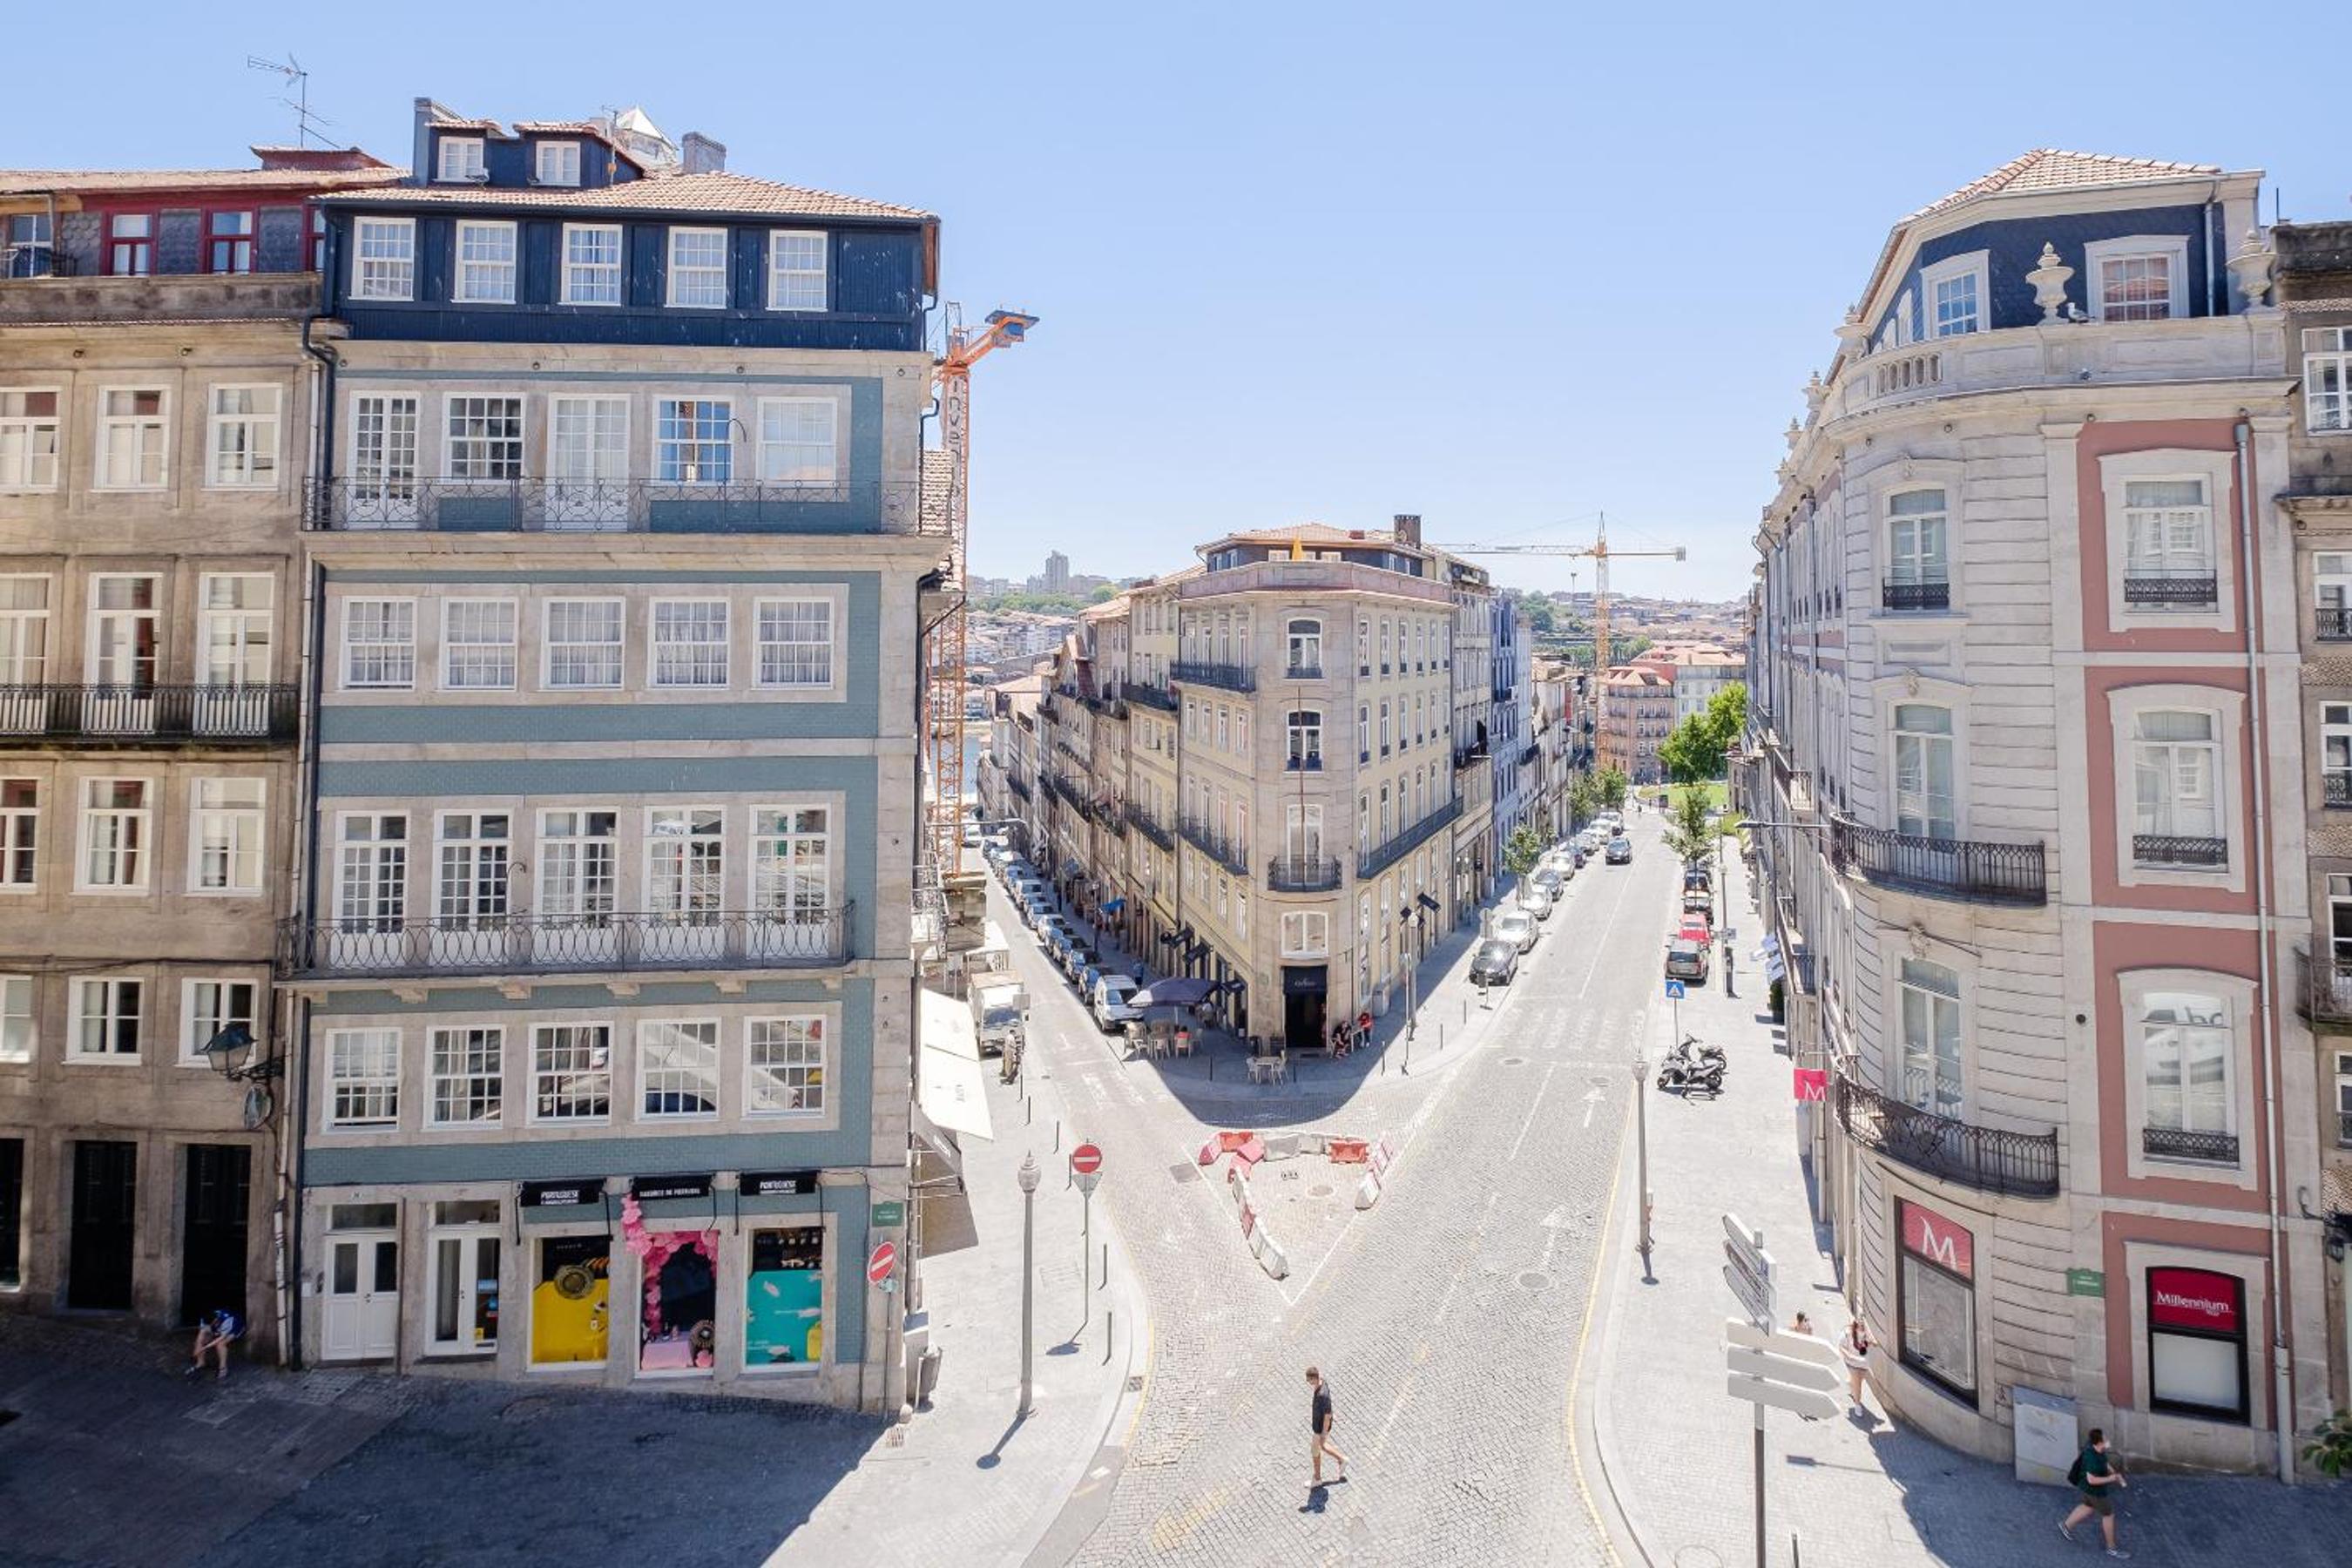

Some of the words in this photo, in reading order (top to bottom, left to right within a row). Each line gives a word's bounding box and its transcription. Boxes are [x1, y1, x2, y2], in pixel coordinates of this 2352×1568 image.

[1804, 1080, 1826, 1102] M
[1918, 1215, 1957, 1271] M
[2156, 1290, 2230, 1313] Millennium
